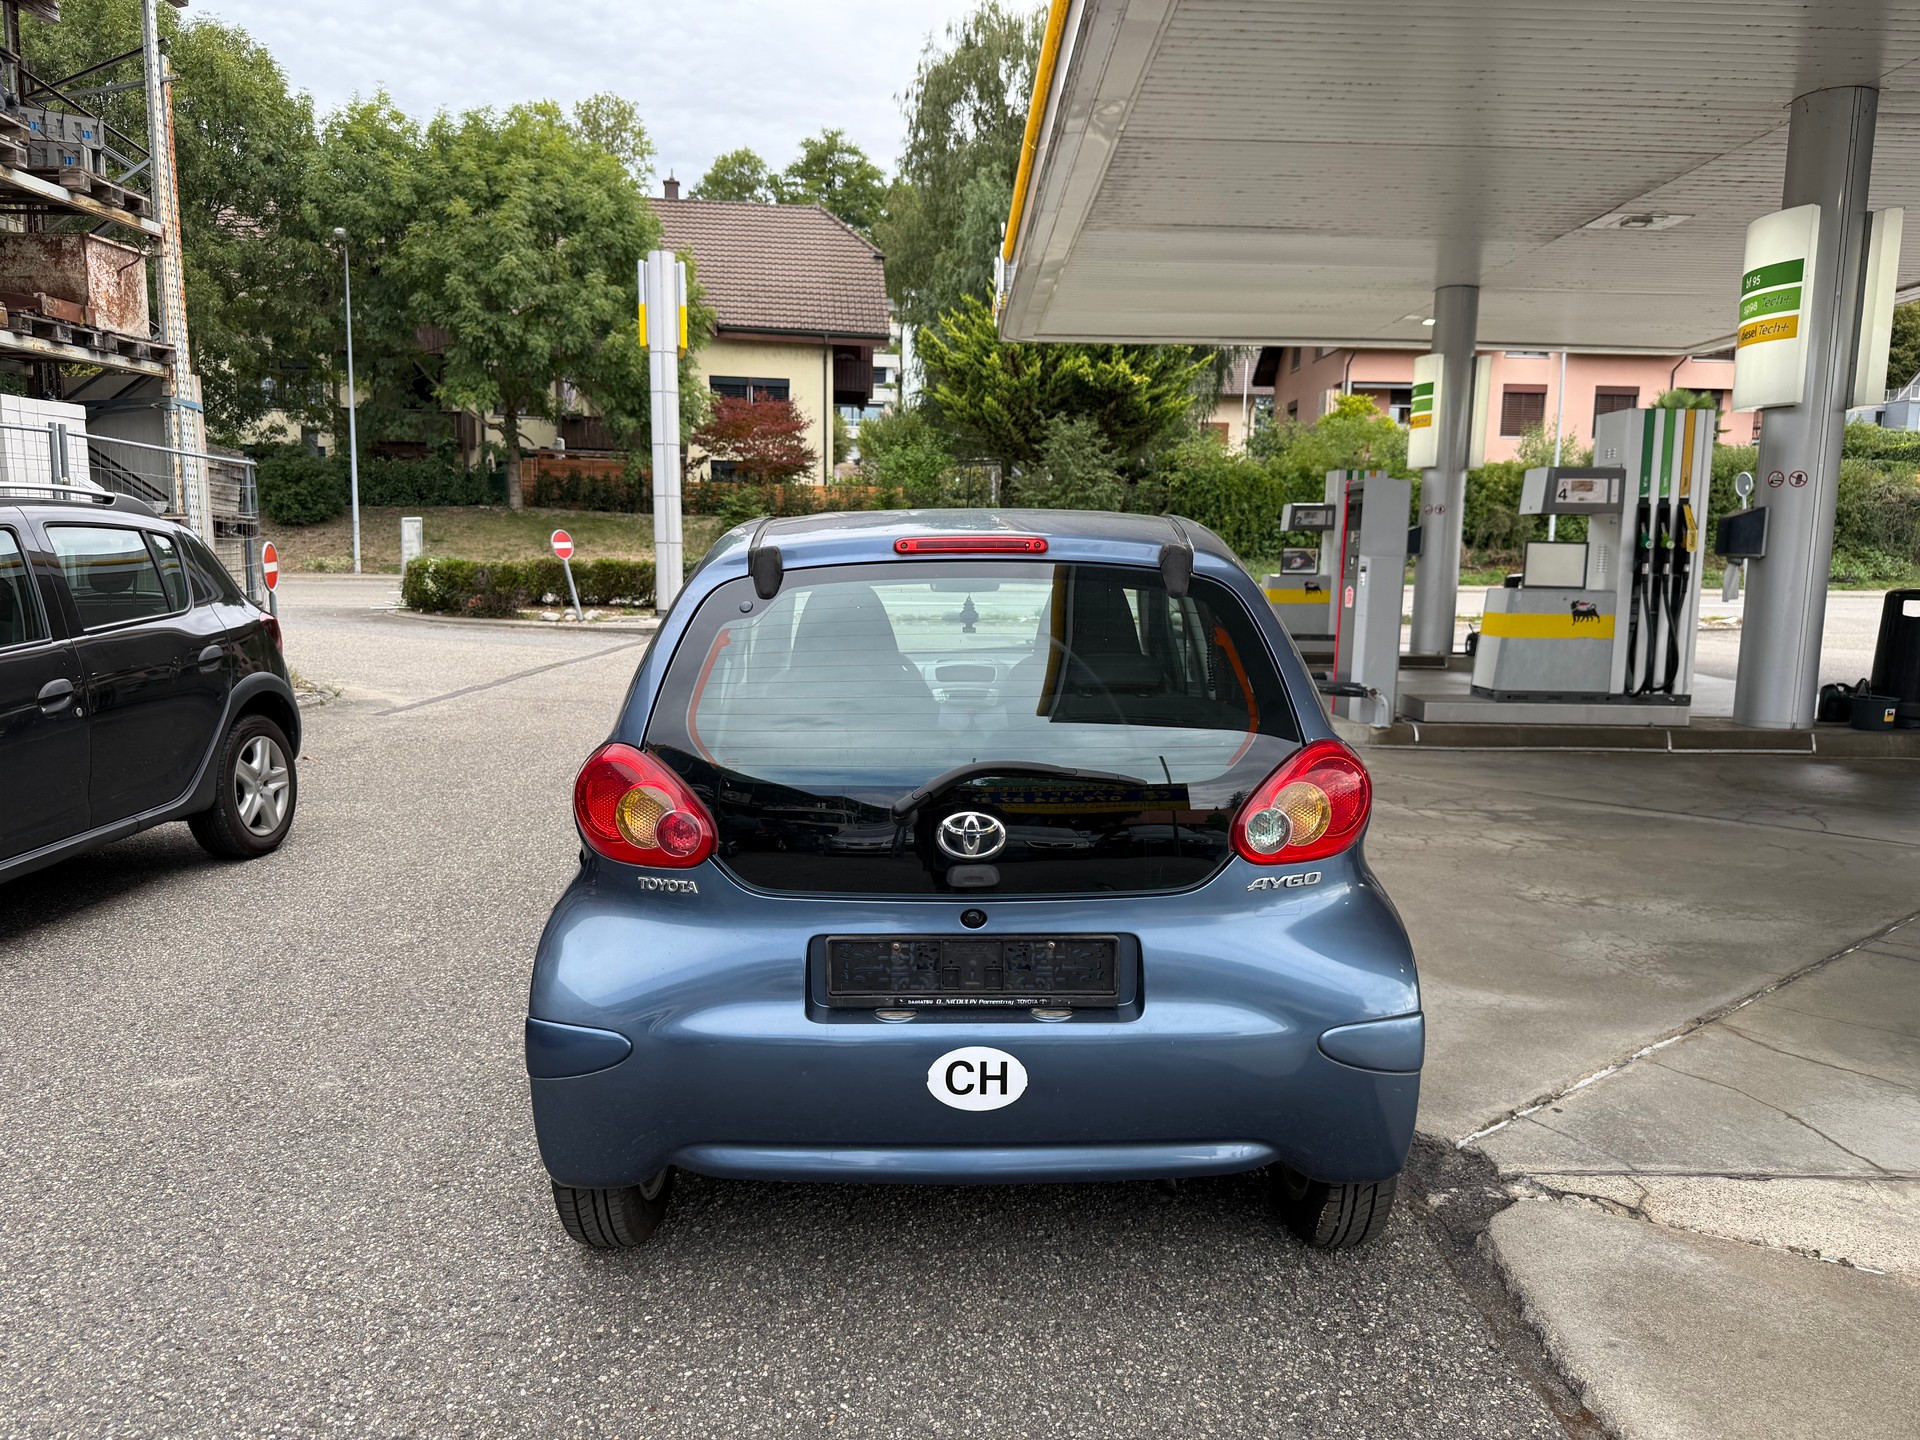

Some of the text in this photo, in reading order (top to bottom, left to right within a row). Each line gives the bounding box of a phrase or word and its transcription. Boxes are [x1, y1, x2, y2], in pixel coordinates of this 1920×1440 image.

[1752, 274, 1761, 286] 95
[1761, 294, 1792, 308] Tech+
[1741, 322, 1789, 341] diesel Tech+
[1557, 488, 1568, 501] 4
[637, 876, 699, 894] TOYOTA
[1246, 871, 1322, 892] AYGO
[979, 998, 1015, 1006] Porrentruy
[945, 1060, 1008, 1096] CH
